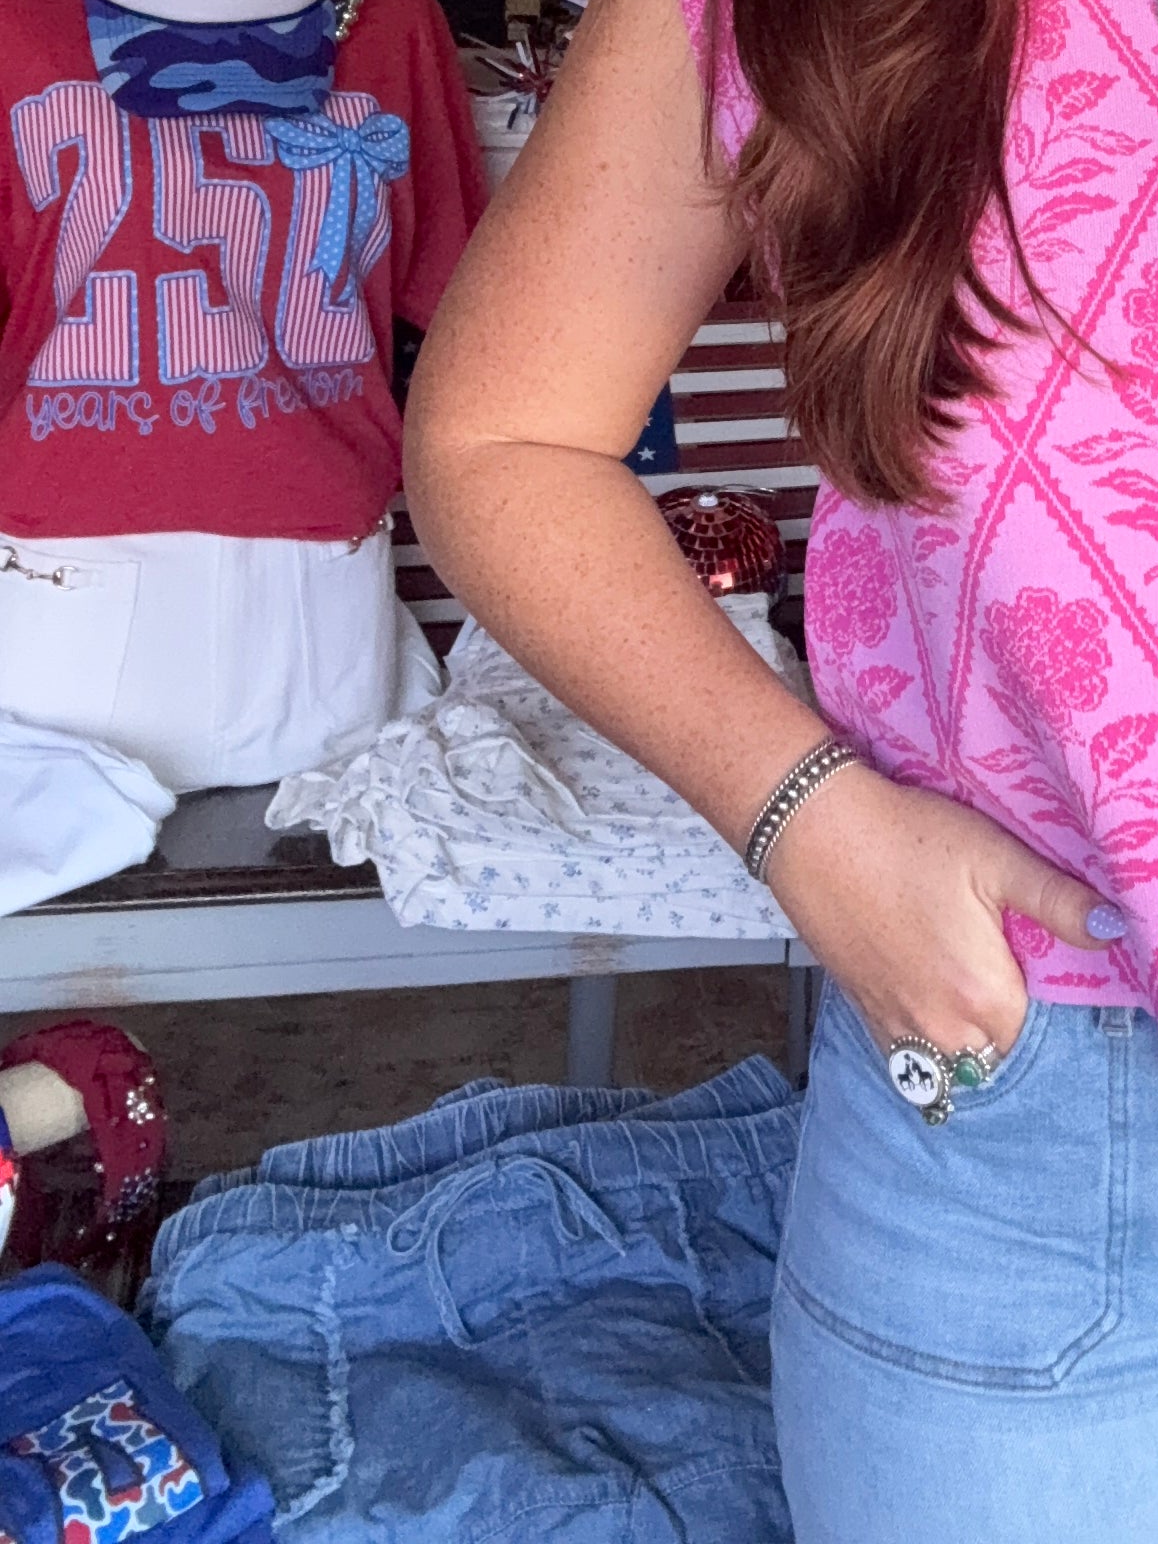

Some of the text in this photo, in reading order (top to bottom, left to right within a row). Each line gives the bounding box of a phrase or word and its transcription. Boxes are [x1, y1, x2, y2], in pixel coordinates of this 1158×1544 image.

[10, 80, 392, 385] 250
[25, 390, 160, 441] years
[170, 378, 226, 434] of
